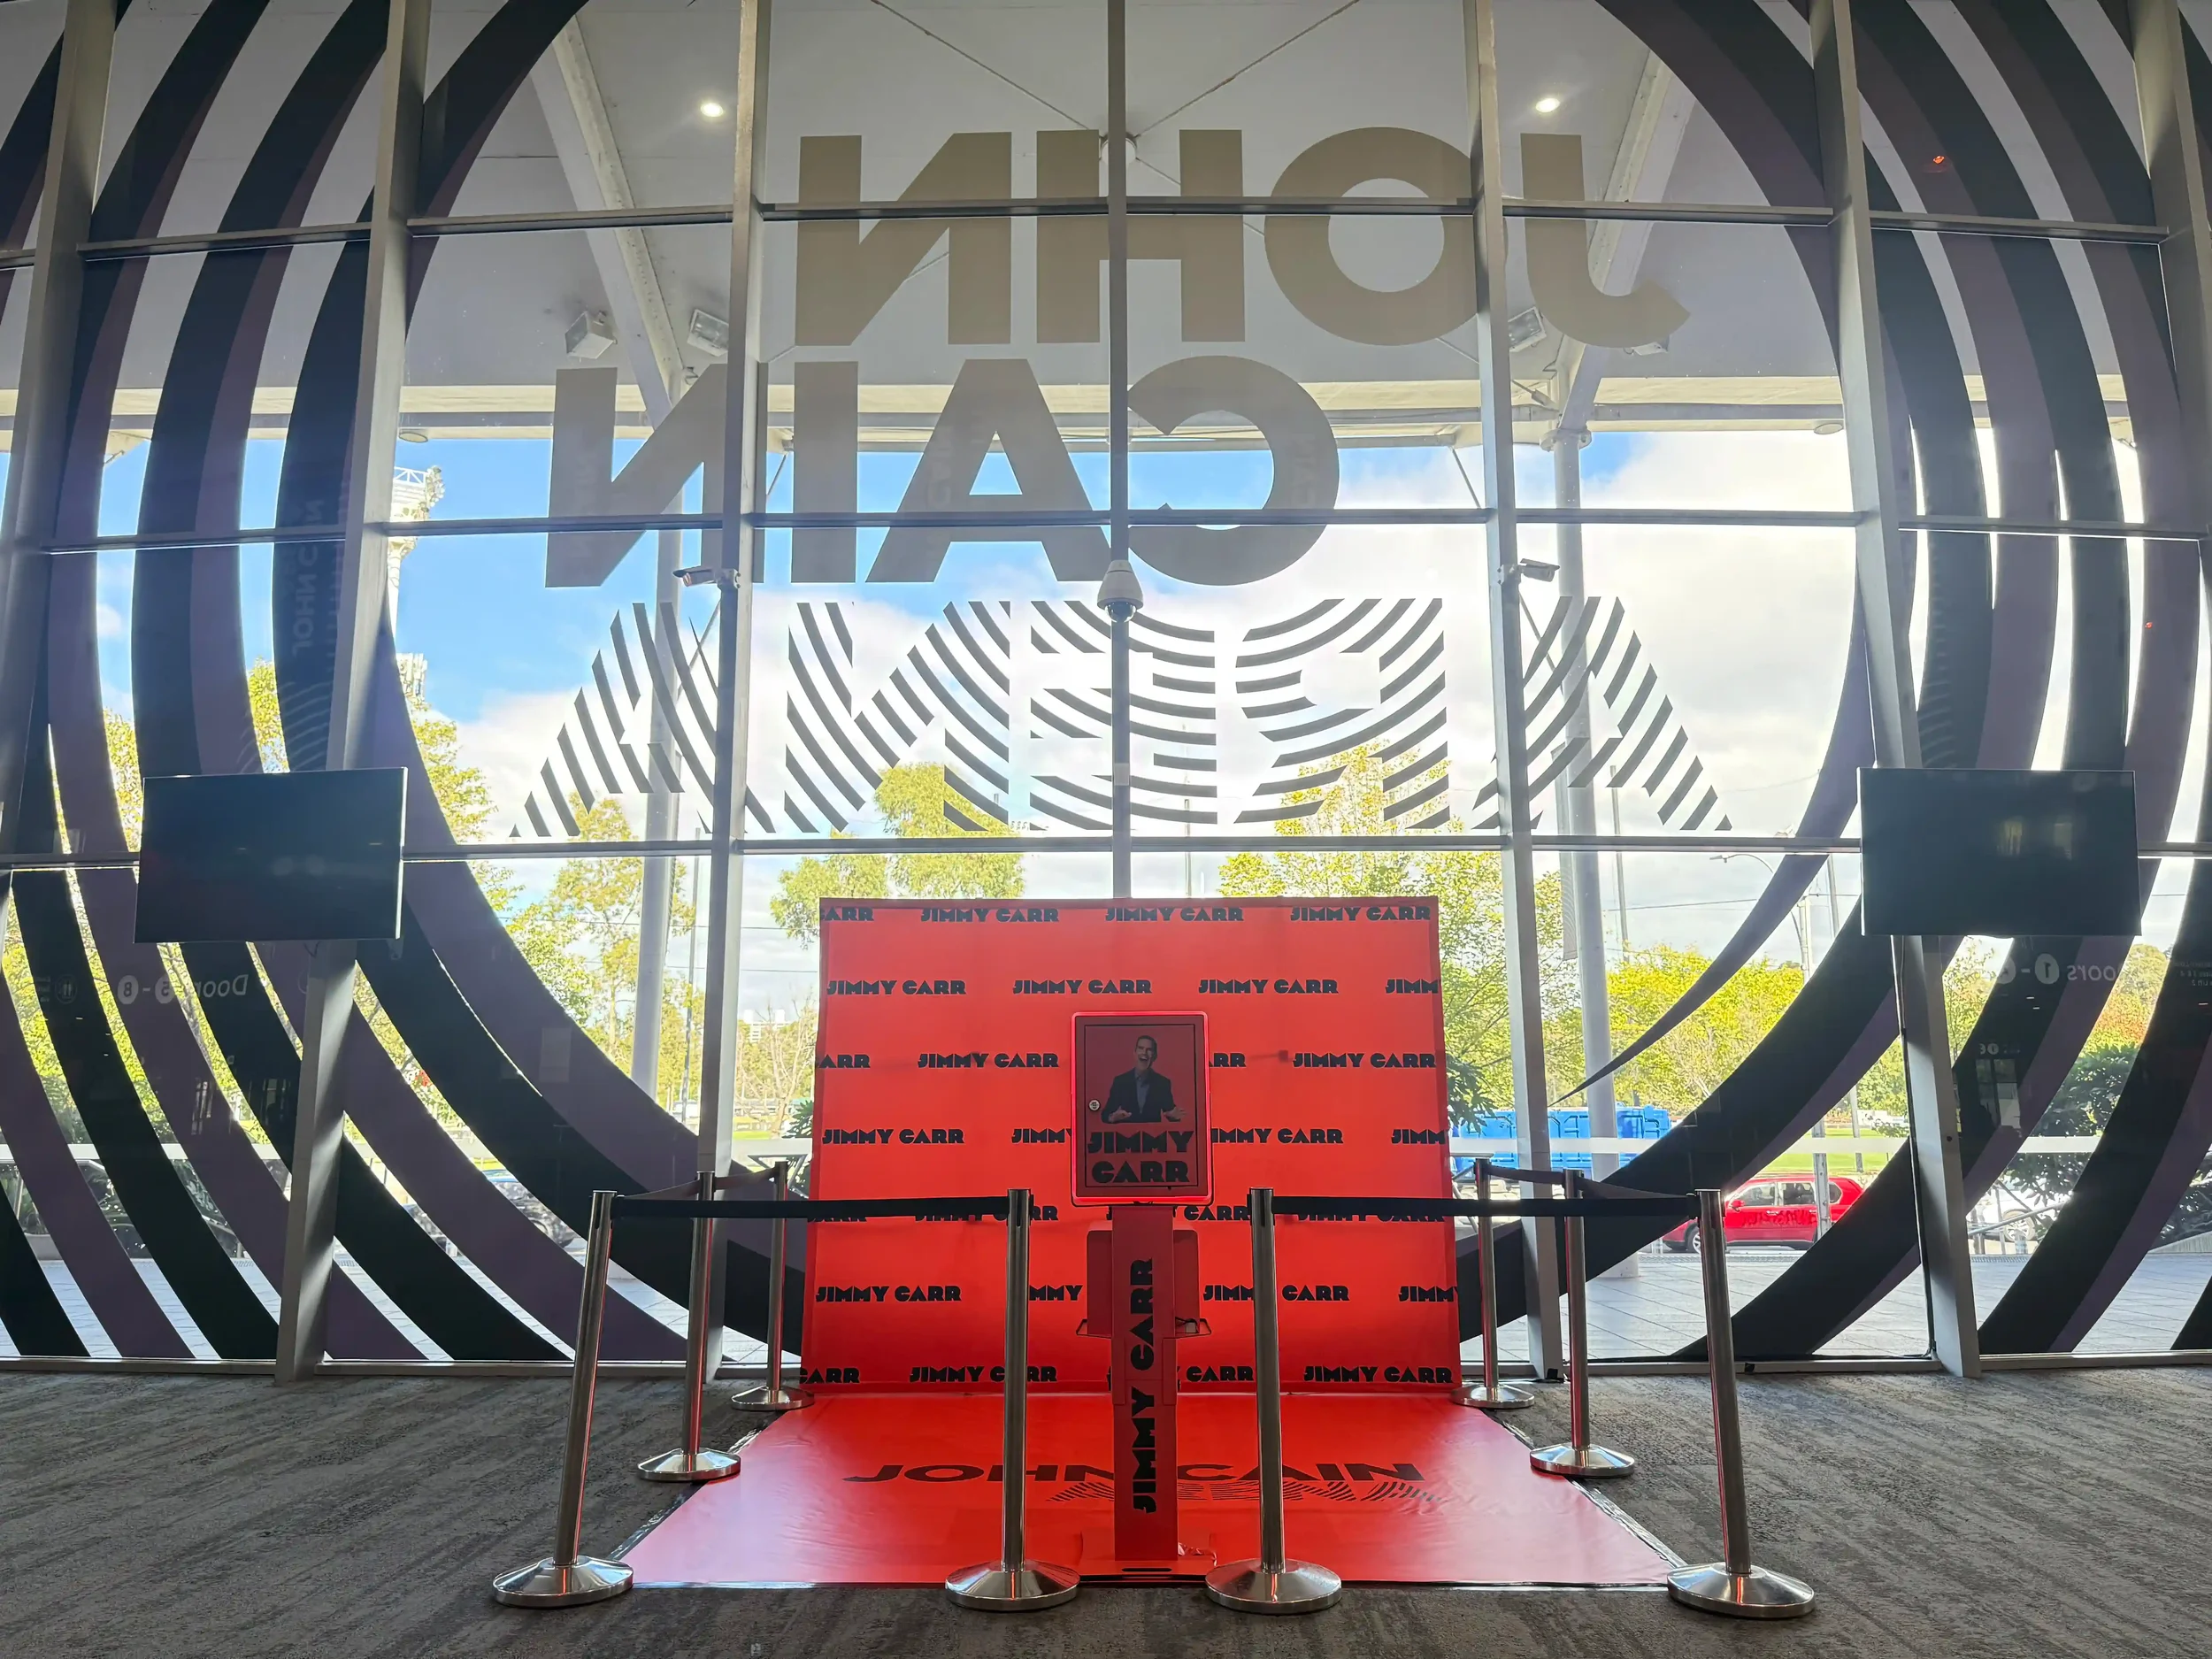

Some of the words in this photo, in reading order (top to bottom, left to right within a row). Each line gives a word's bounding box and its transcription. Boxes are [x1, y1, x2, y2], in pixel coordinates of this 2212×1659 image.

[822, 906, 873, 920] ARR
[922, 907, 989, 922] JIMMY
[996, 908, 1057, 922] CARR
[1106, 907, 1173, 921] JIMMY
[1181, 907, 1242, 920] CARR
[1291, 906, 1360, 920] JIMMY
[1367, 906, 1431, 920] CARR
[827, 980, 896, 995] JIMMY
[902, 980, 965, 995] CARR
[1014, 980, 1082, 994] JIMMY
[1089, 980, 1151, 994] CARR
[1199, 980, 1267, 993] JIMMY
[1274, 979, 1337, 994] CARR
[1386, 979, 1439, 994] JIMM
[820, 1055, 870, 1069] ARR
[918, 1053, 988, 1068] JIMMY
[995, 1054, 1058, 1067] CARR
[1210, 1053, 1245, 1067] RR
[1294, 1054, 1363, 1067] JIMMY
[1371, 1053, 1437, 1068] CARR
[823, 1129, 893, 1144] JIMMY
[899, 1129, 964, 1143] CARR
[1087, 1131, 1194, 1154] JIMMY
[1212, 1129, 1271, 1143] IMMY
[1278, 1129, 1342, 1143] CARR
[1392, 1129, 1447, 1145] JIMM
[1092, 1161, 1189, 1184] CARR
[1033, 1205, 1059, 1220] RR
[1184, 1205, 1250, 1220] CARR
[816, 1286, 889, 1302] JIMMY
[895, 1286, 961, 1302] CARR
[1029, 1286, 1083, 1301] MMY
[1203, 1286, 1255, 1301] JIMM
[1282, 1286, 1349, 1301] CARR
[1399, 1286, 1456, 1302] JIMM
[1130, 1258, 1155, 1371] CARR
[910, 1366, 985, 1384] JIMMY
[990, 1365, 1057, 1384] CRR
[1187, 1366, 1254, 1384] CARR
[1303, 1366, 1378, 1383] JIMMY
[1384, 1366, 1455, 1386] CARR
[1131, 1386, 1156, 1514] JIMMY
[841, 1464, 1115, 1482] JOHN
[1177, 1463, 1425, 1481] CAIN
